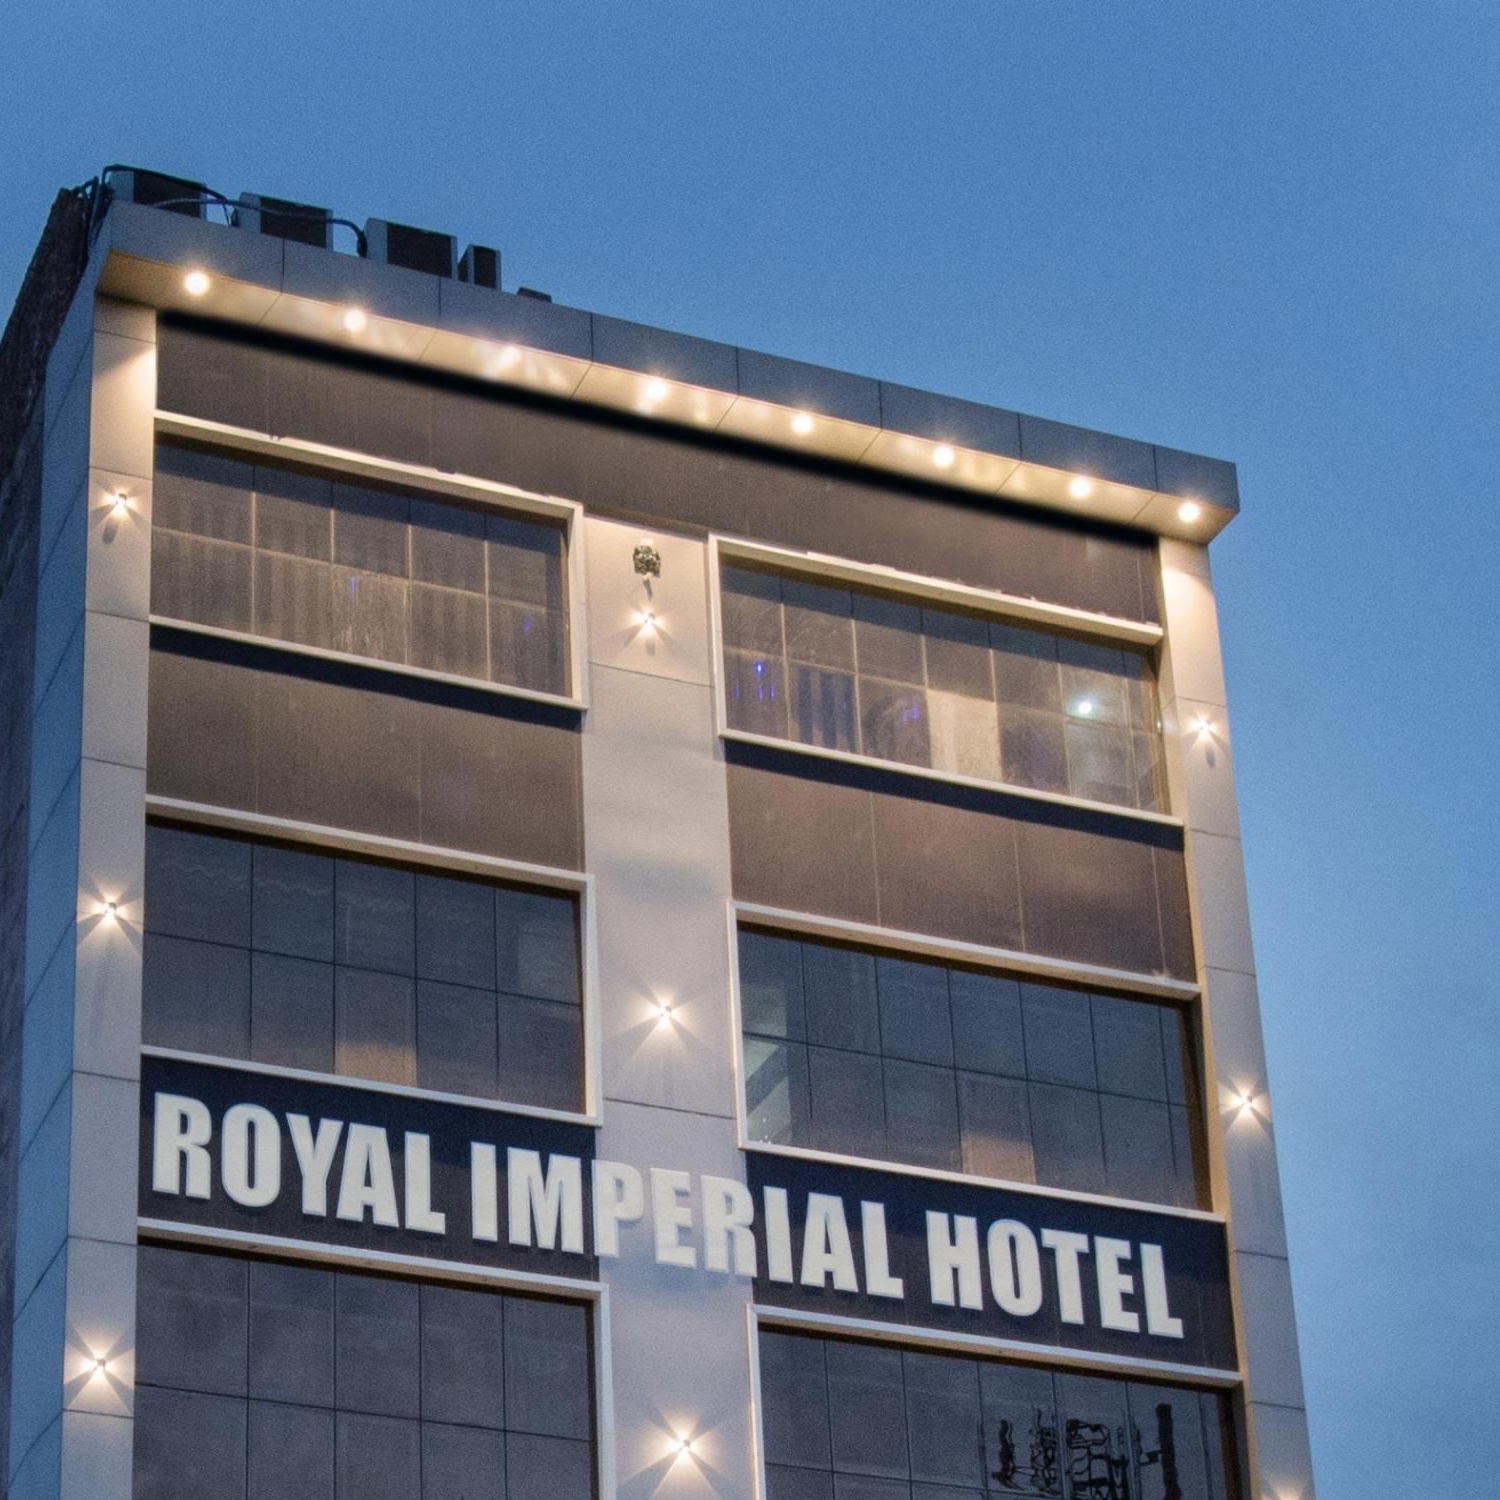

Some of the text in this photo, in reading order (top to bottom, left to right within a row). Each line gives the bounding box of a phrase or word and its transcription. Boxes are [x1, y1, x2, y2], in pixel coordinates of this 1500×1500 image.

[152, 1090, 1185, 1340] ROYAL IMPERIAL HOTEL
